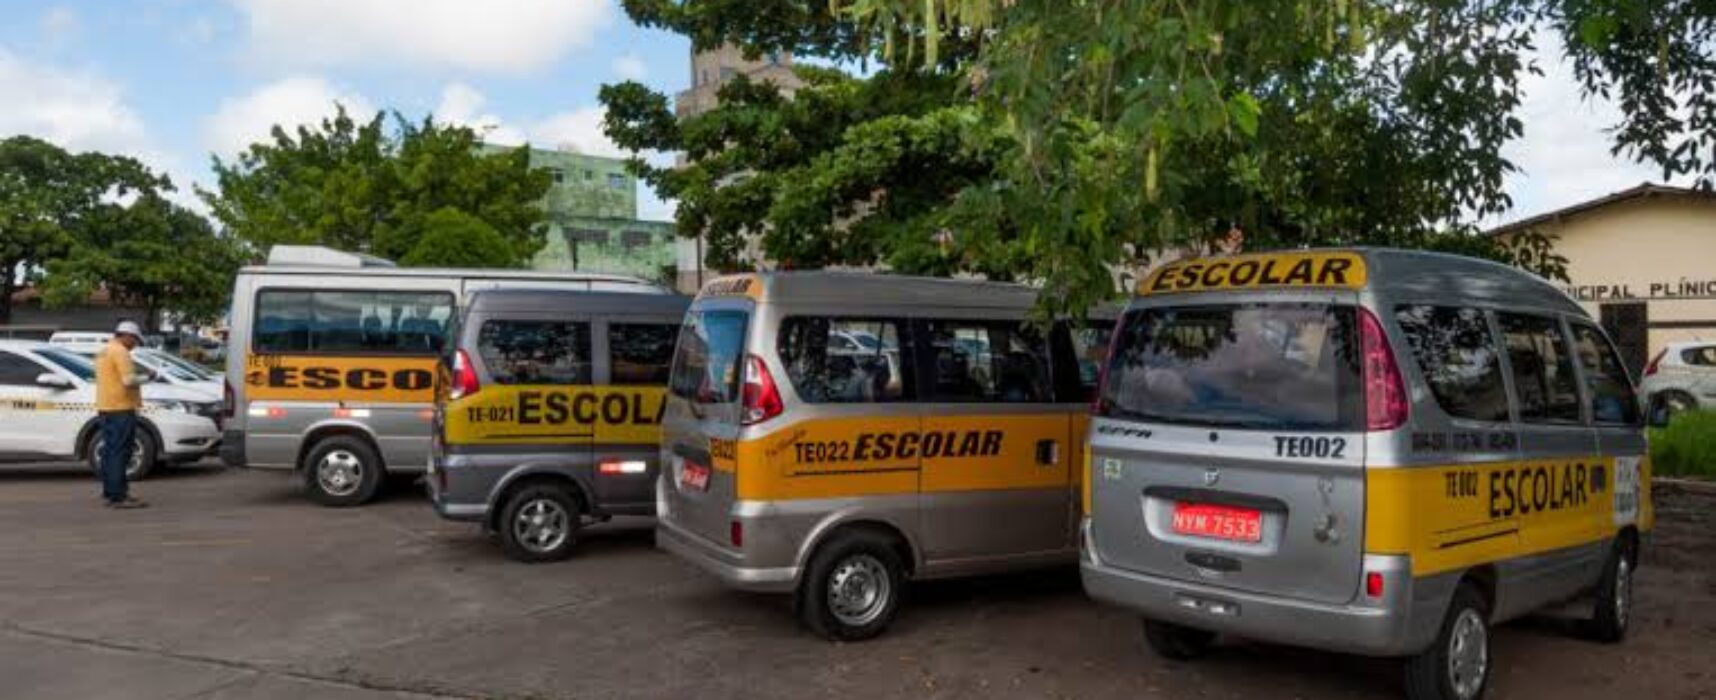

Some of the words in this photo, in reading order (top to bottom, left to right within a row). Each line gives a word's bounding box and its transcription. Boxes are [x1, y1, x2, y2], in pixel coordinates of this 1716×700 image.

[1151, 258, 1352, 290] ESCOLAR
[1566, 284, 1637, 300] ICIPAL
[269, 367, 432, 389] ESCO
[467, 406, 514, 423] TE-021
[795, 440, 849, 464] TE022
[853, 431, 1003, 461] ESCOLAR
[1274, 435, 1346, 458] TE002
[1445, 472, 1457, 497] TE
[1489, 464, 1587, 518] ESCOLAR
[1213, 514, 1259, 537] 7533
